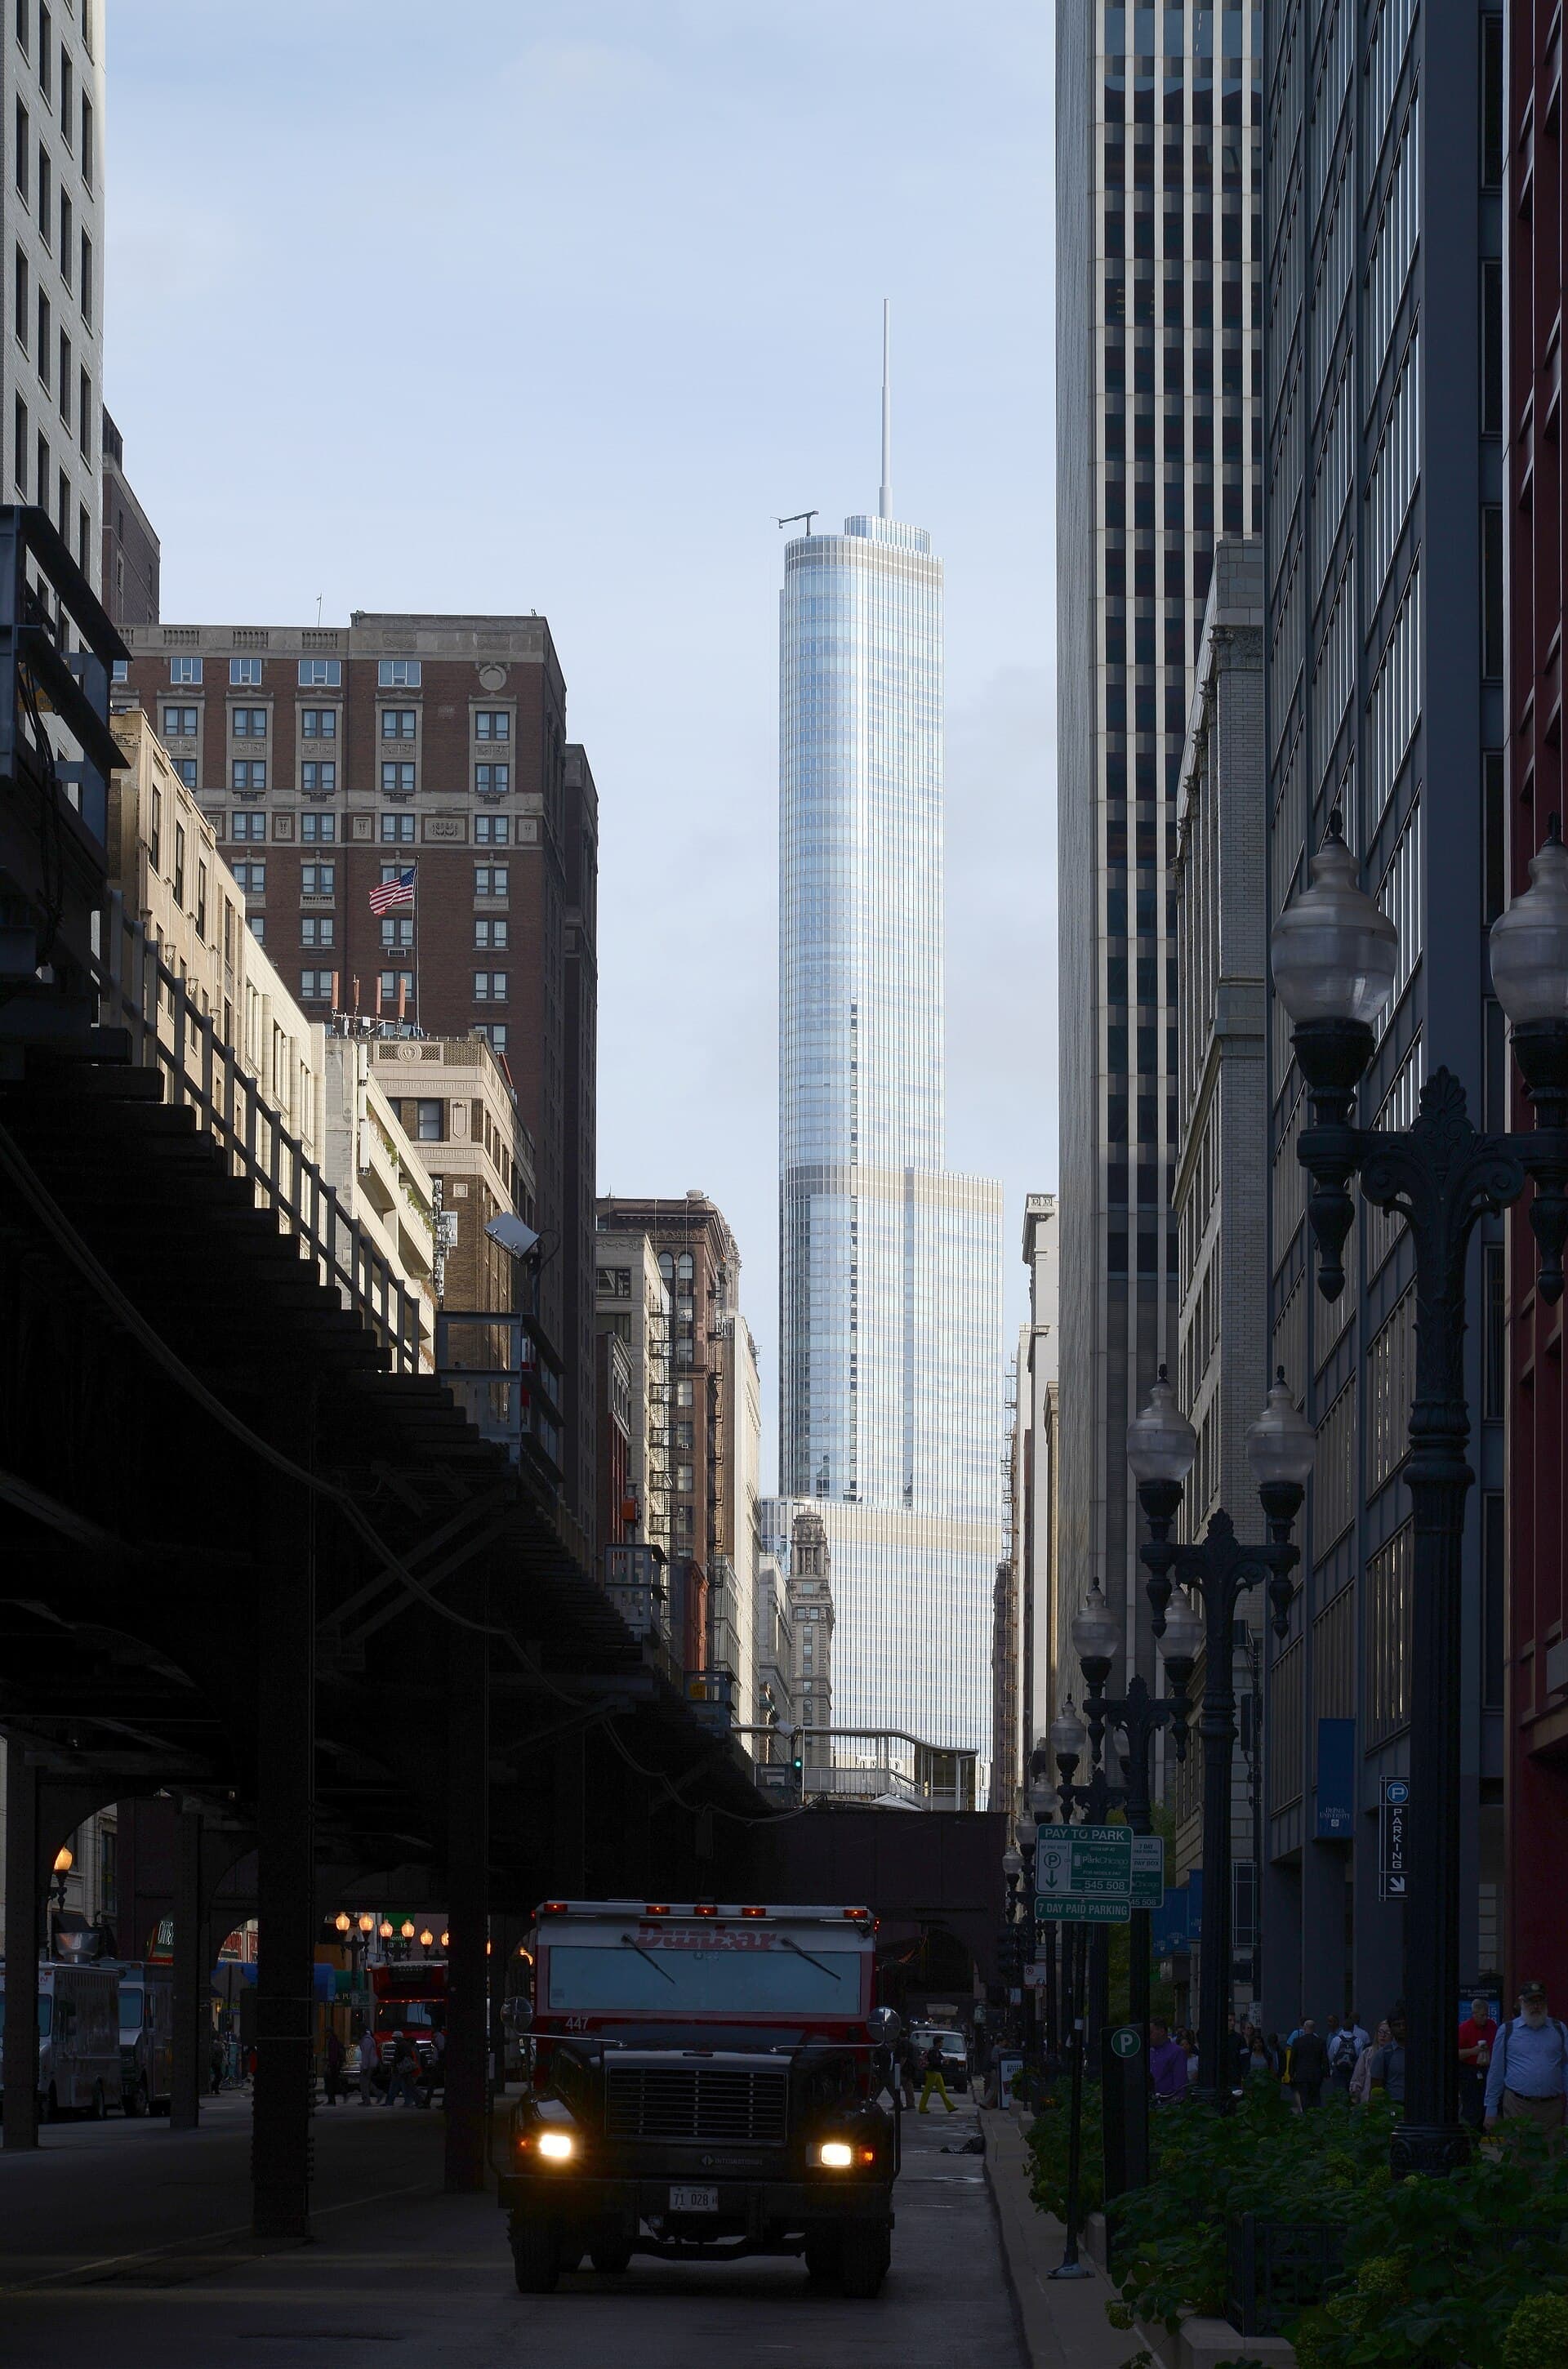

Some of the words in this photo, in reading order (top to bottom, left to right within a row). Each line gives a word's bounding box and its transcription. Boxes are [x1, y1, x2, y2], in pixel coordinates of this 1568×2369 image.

[1045, 1828, 1068, 1839] PAY
[1071, 1829, 1089, 1839] TO
[1091, 1830, 1125, 1841] PARK
[1392, 1808, 1403, 1869] PARKING
[1085, 1881, 1103, 1890] 545
[1106, 1881, 1125, 1890] 508
[1038, 1903, 1045, 1913] 7
[1046, 1903, 1064, 1914] DAY
[1066, 1904, 1086, 1914] PAID
[1089, 1904, 1128, 1916] PARKING
[1141, 1899, 1156, 1907] 508
[635, 1921, 777, 1950] Dunbar
[565, 2016, 589, 2031] 447
[1120, 2033, 1134, 2053] P
[691, 2193, 709, 2206] 028
